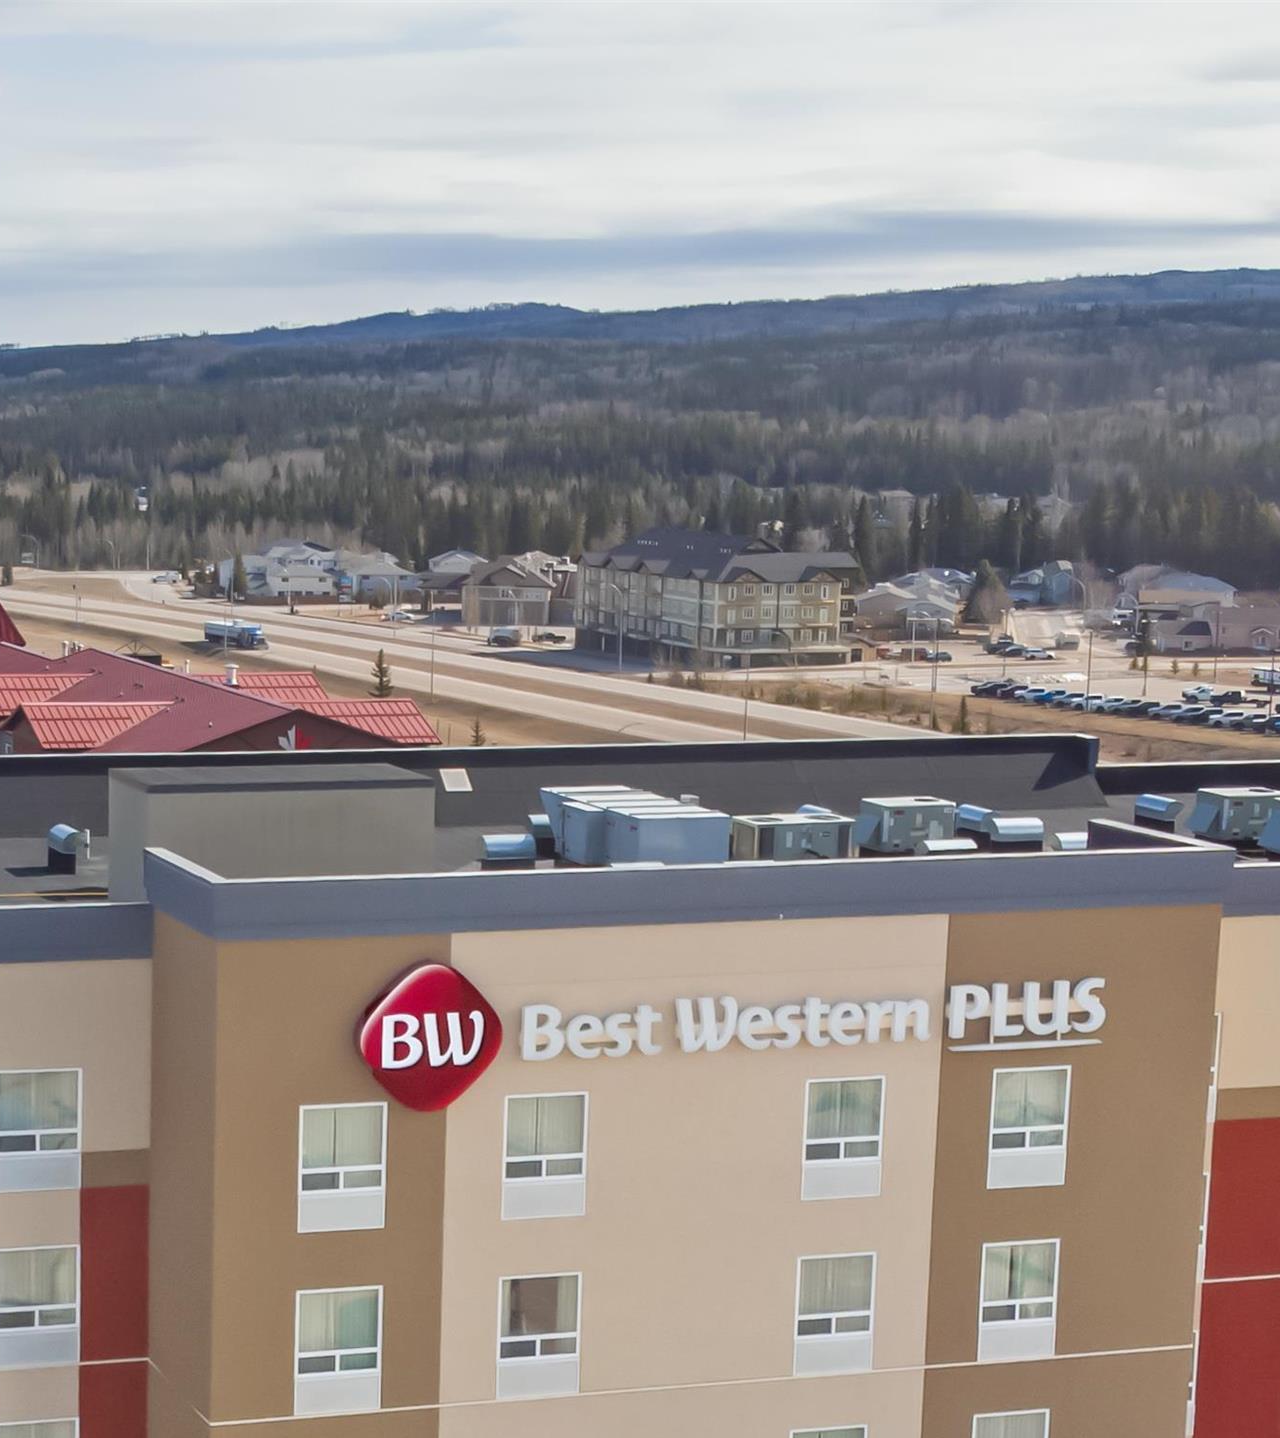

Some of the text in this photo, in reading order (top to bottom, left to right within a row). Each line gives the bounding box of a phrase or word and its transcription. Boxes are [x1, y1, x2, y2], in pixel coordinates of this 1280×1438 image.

[380, 1009, 485, 1070] BW
[520, 976, 1107, 1062] Best Western PLUS
